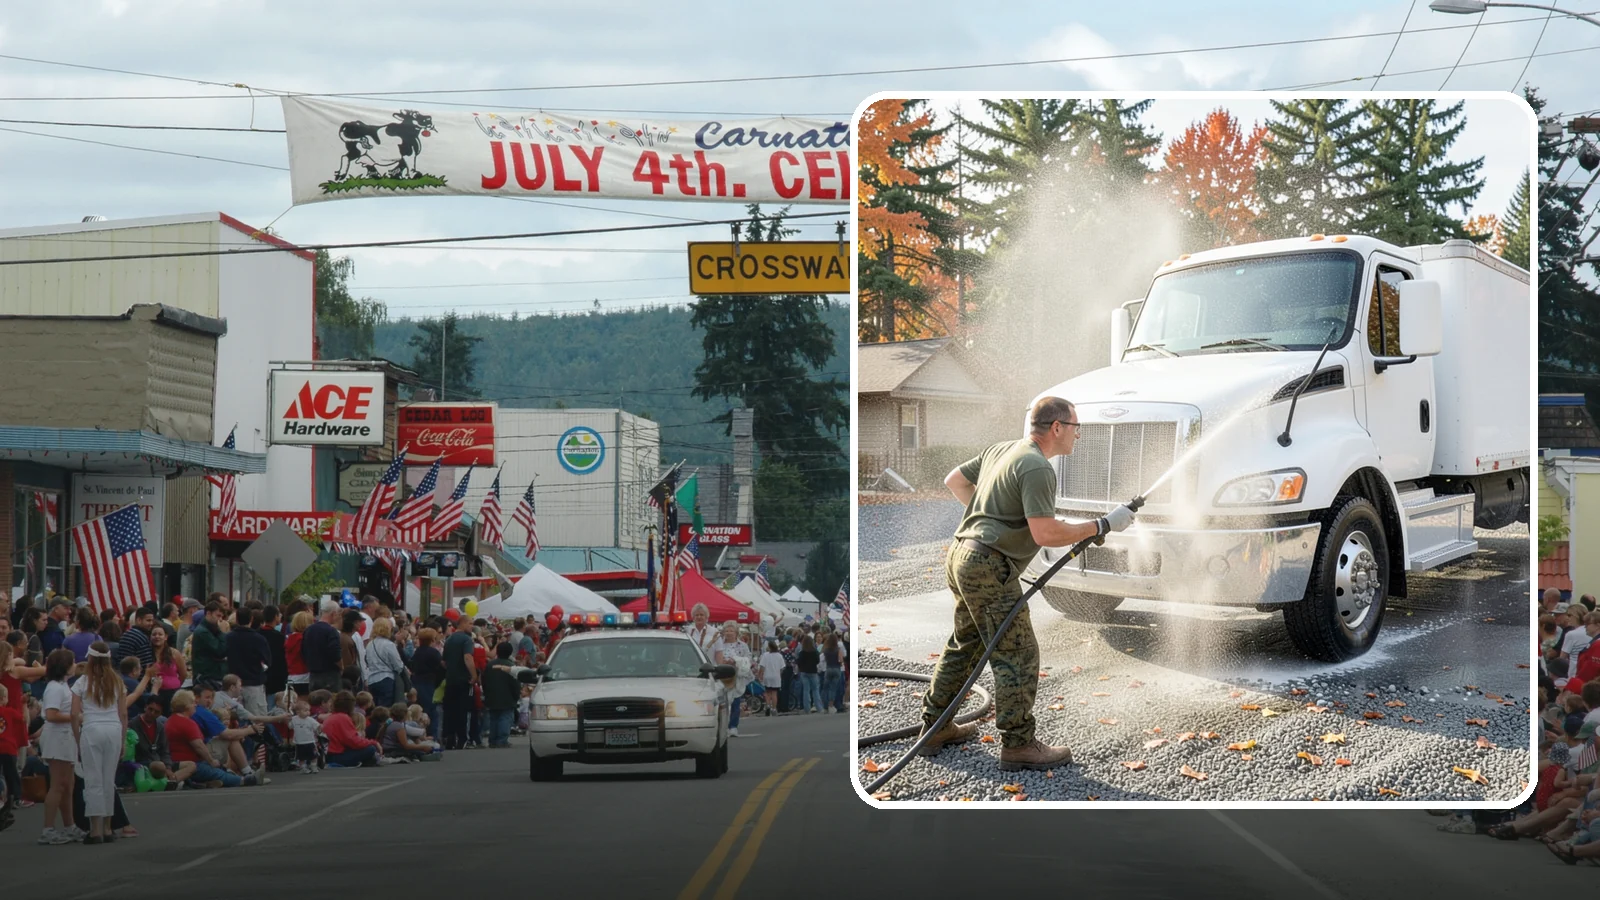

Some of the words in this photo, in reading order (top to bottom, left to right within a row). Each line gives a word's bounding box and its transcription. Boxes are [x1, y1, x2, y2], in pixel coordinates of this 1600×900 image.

[695, 121, 850, 150] Carnat
[481, 141, 605, 192] JULY
[632, 150, 747, 198] 4th.
[697, 254, 850, 279] CROSSWA
[282, 380, 374, 420] ACE
[405, 409, 452, 422] CEDAR
[461, 409, 485, 422] LOG
[283, 421, 371, 437] Hardware
[416, 428, 477, 446] Coca-Cola
[353, 467, 386, 480] Simpl
[83, 485, 93, 494] St.
[95, 485, 124, 494] Vincent
[126, 485, 135, 494] de
[137, 485, 155, 495] Paul
[688, 526, 741, 535] CRNATION
[699, 535, 730, 543] GLASS
